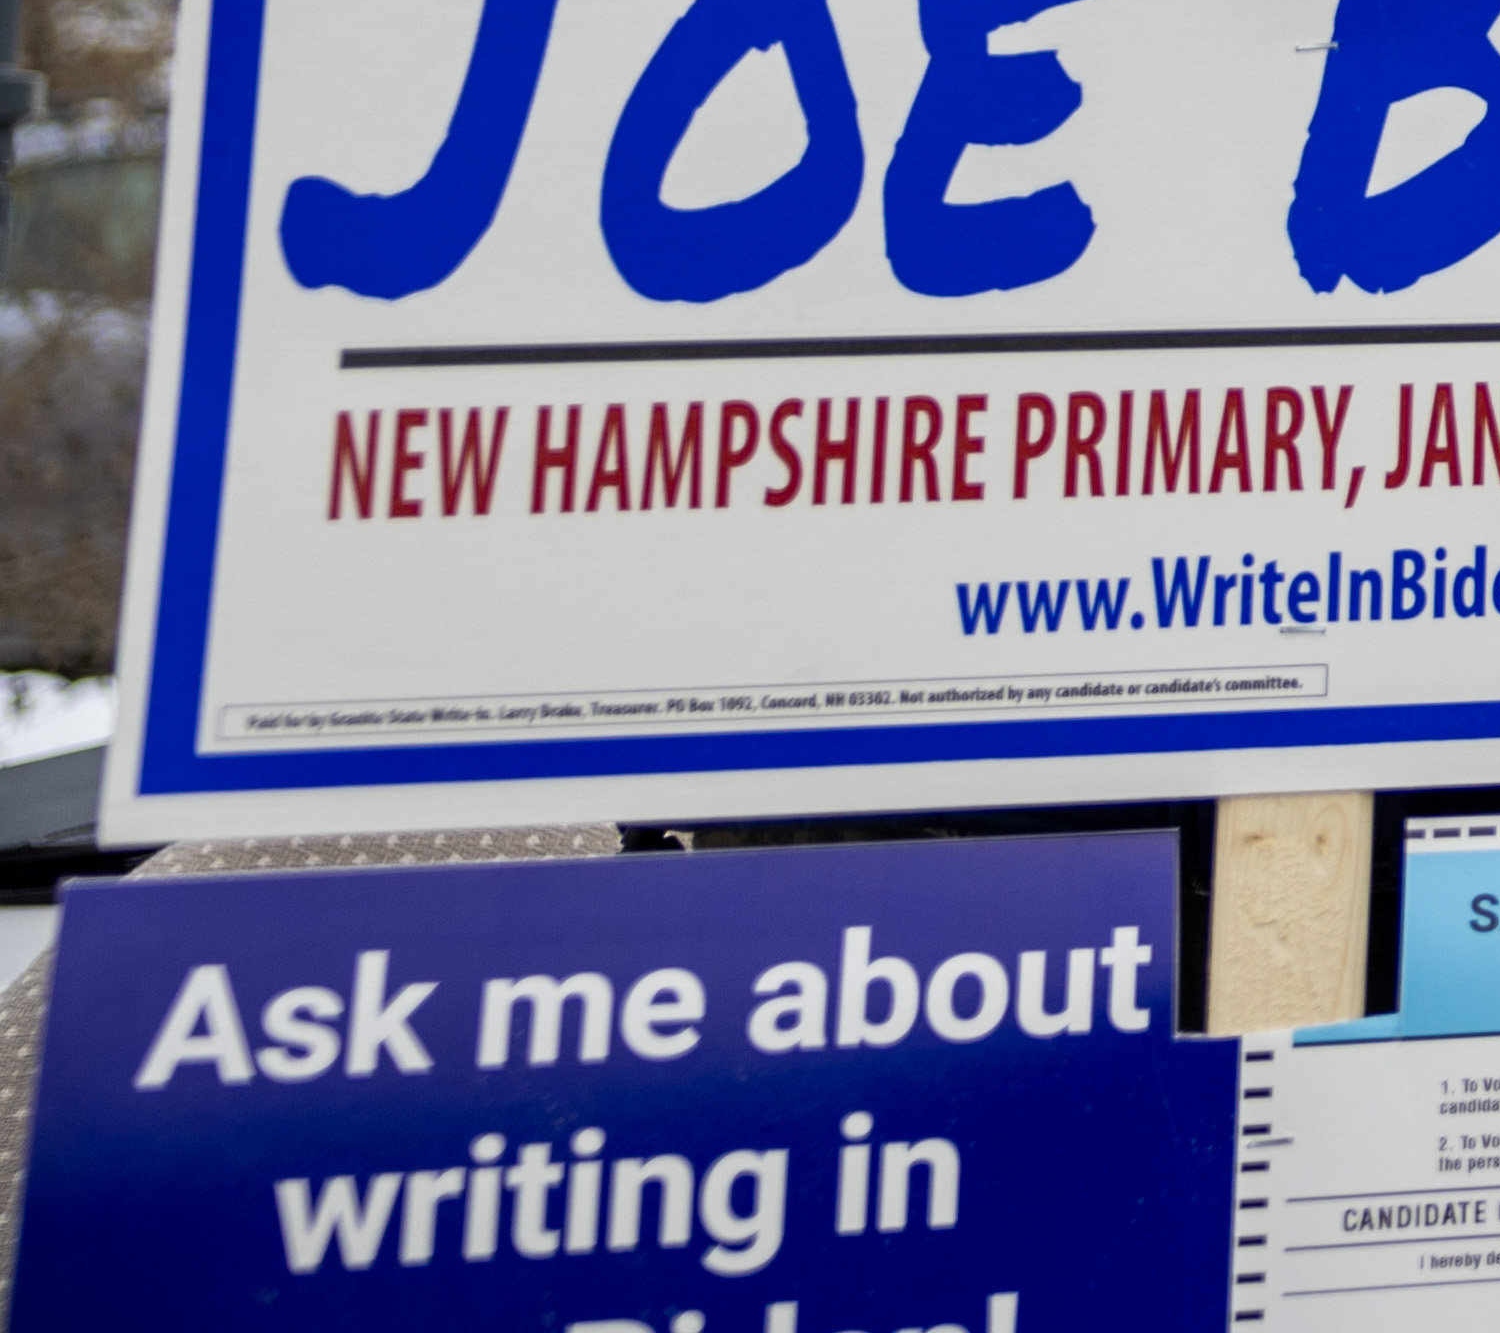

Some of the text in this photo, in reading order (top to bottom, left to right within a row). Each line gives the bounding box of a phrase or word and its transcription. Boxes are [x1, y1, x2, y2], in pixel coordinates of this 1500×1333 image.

[328, 406, 509, 521] NEW
[530, 394, 988, 515] HAMPSHIRE
[1012, 385, 1365, 507] PRIMARY,
[136, 925, 1153, 1088] Ask me about
[275, 1111, 960, 1275] writing in
[1342, 1200, 1486, 1232] CANDIDATE
